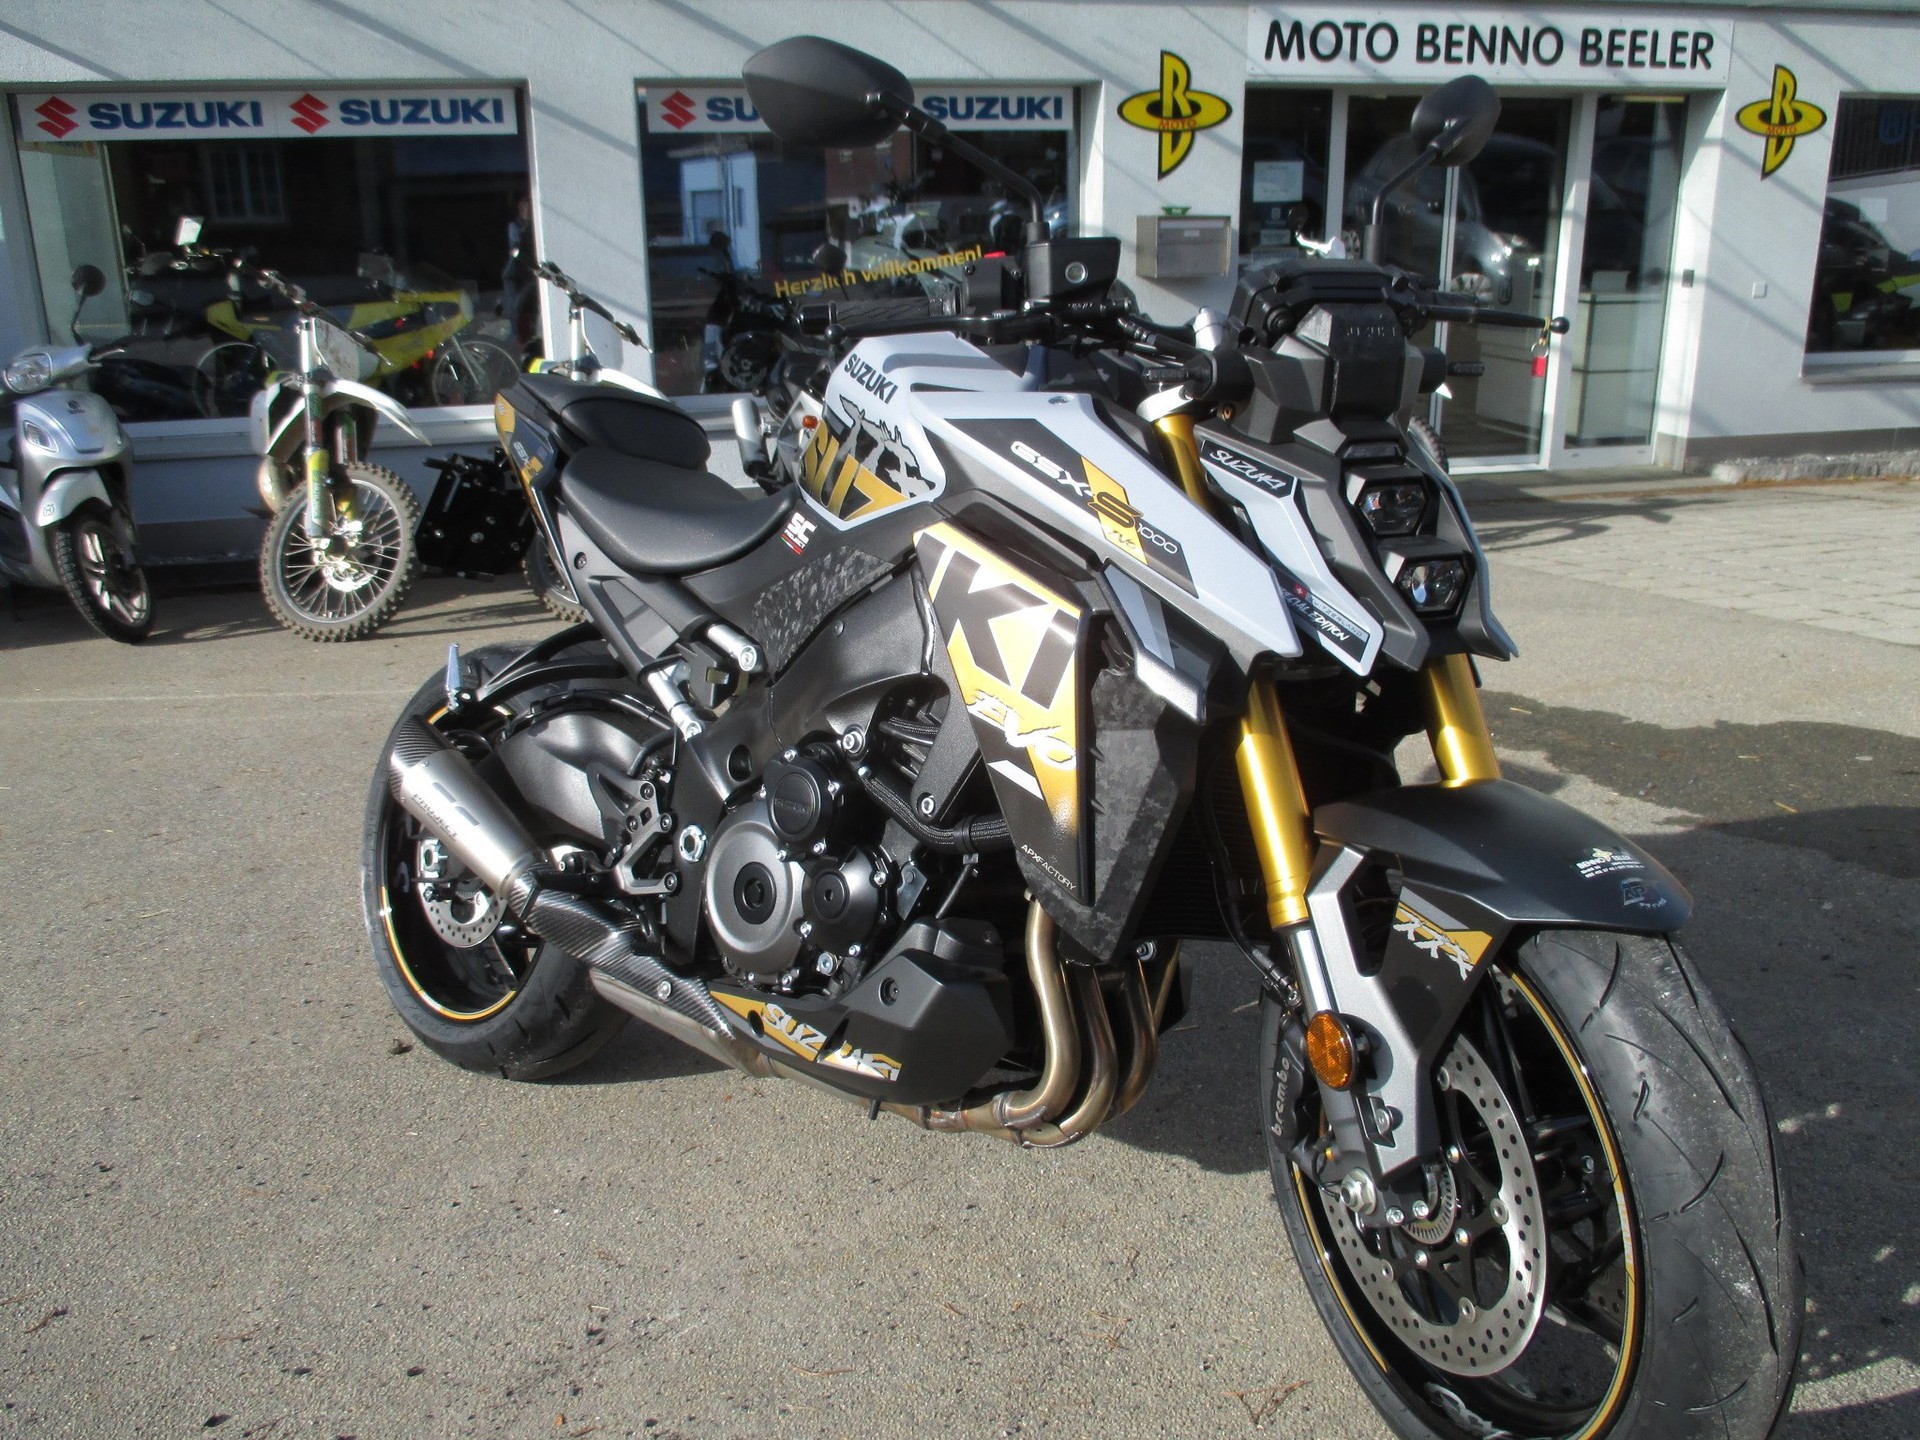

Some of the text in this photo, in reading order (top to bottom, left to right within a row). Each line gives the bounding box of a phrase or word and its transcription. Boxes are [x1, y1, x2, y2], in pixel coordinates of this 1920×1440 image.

[1264, 20, 1715, 70] MOTO BENNO BEELER
[89, 100, 265, 130] SUZUKI
[340, 97, 505, 126] SUZUKI
[922, 96, 1063, 121] SUZUKI
[1158, 118, 1197, 129] MOTO
[1766, 125, 1797, 136] MOTO
[860, 243, 984, 283] willkommen!
[844, 352, 899, 405] SUZUKI
[1209, 449, 1287, 491] SUZUKI
[787, 512, 817, 545] SC
[1308, 610, 1350, 641] EDITION
[1270, 1056, 1290, 1136] brembo
